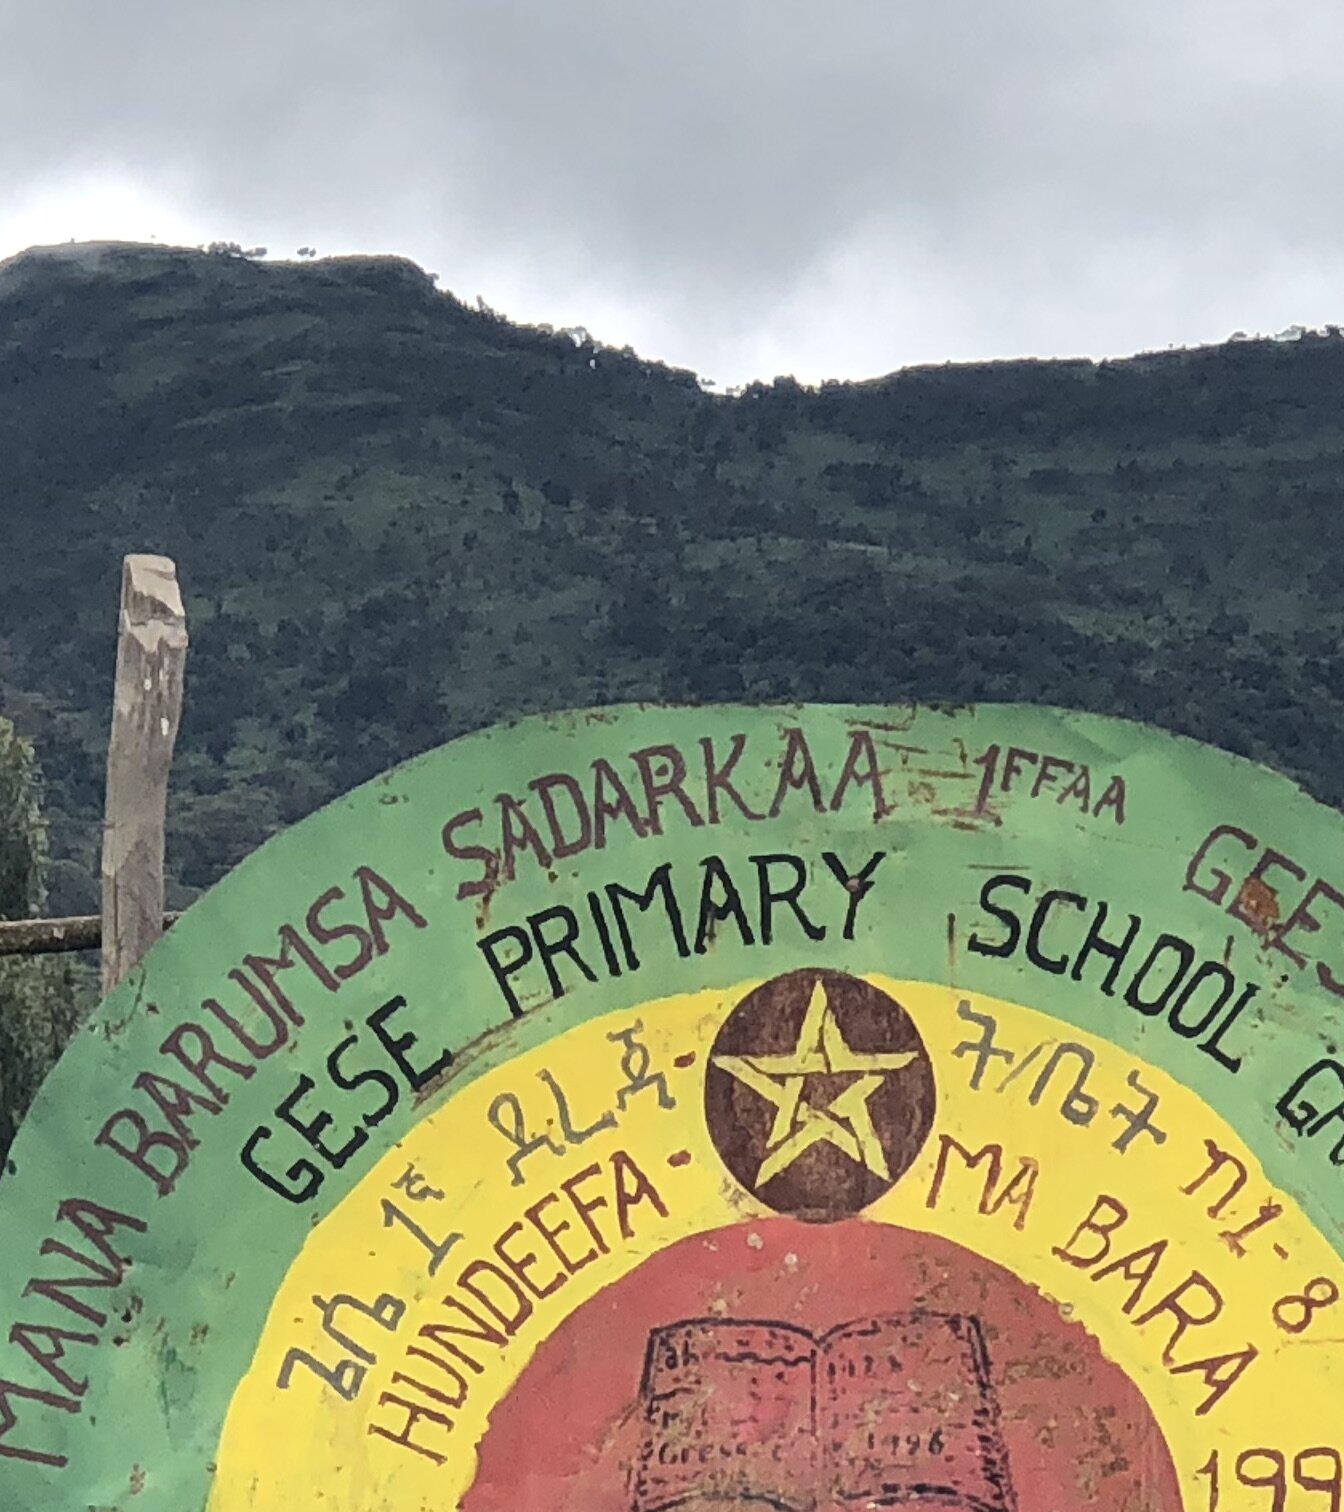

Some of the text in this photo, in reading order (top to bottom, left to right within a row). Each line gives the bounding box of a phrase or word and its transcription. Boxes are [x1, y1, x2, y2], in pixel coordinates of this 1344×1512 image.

[95, 864, 429, 1198] BARUMSA
[440, 727, 887, 904] SADARKAA
[239, 996, 455, 1205] GESE
[477, 852, 887, 1019] PRIMARY
[967, 874, 1262, 1073] SCHOOL
[924, 1133, 1040, 1232] MA
[1051, 1193, 1259, 1418] BARA
